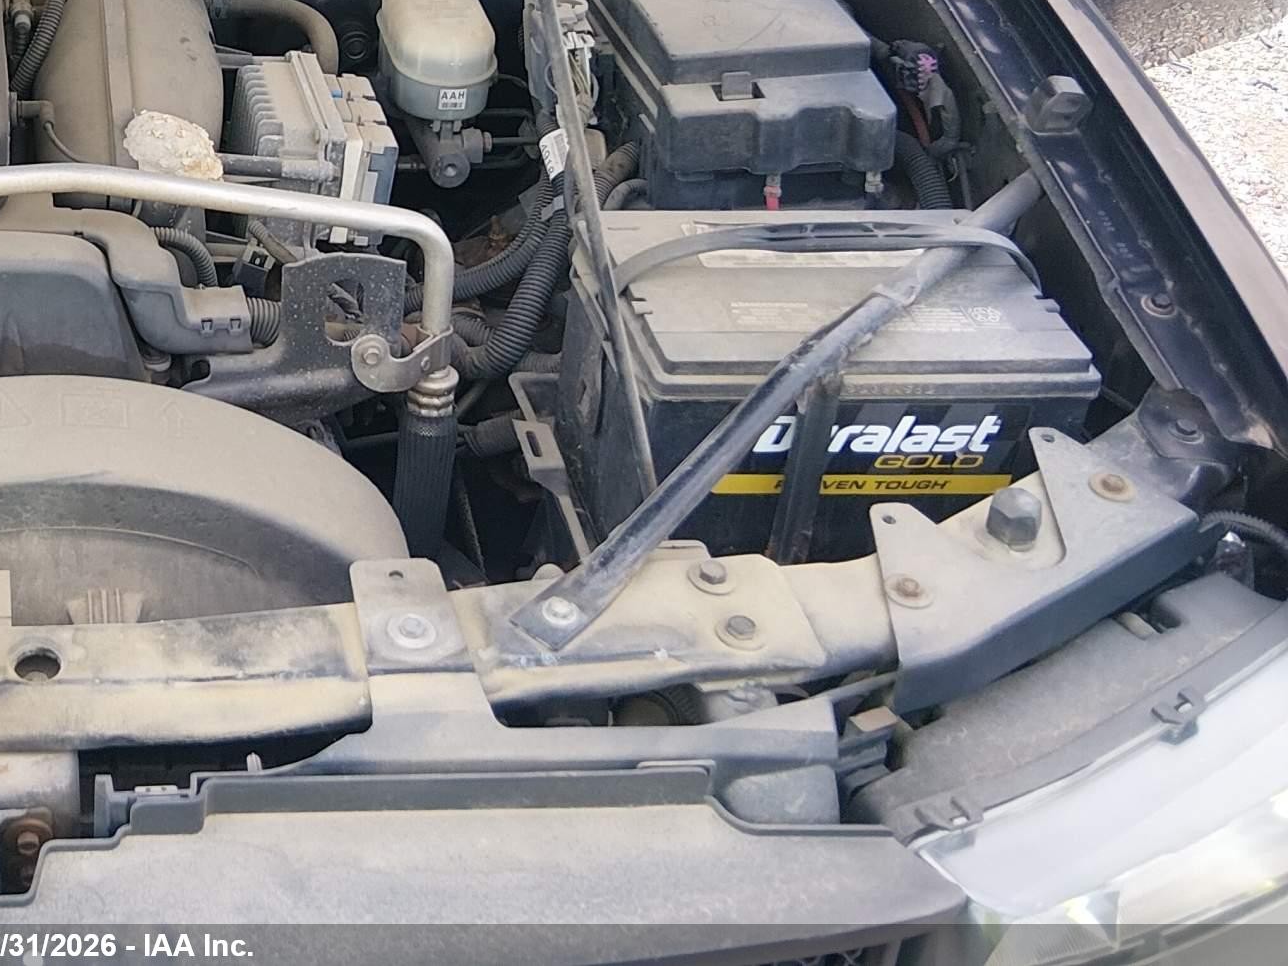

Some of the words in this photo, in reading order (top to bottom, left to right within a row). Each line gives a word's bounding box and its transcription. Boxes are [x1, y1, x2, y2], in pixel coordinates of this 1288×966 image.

[441, 90, 465, 100] AAH
[752, 415, 1001, 453] Dralast
[873, 454, 984, 469] GOLD
[773, 479, 867, 490] PVEN
[873, 480, 948, 490] TOUGH
